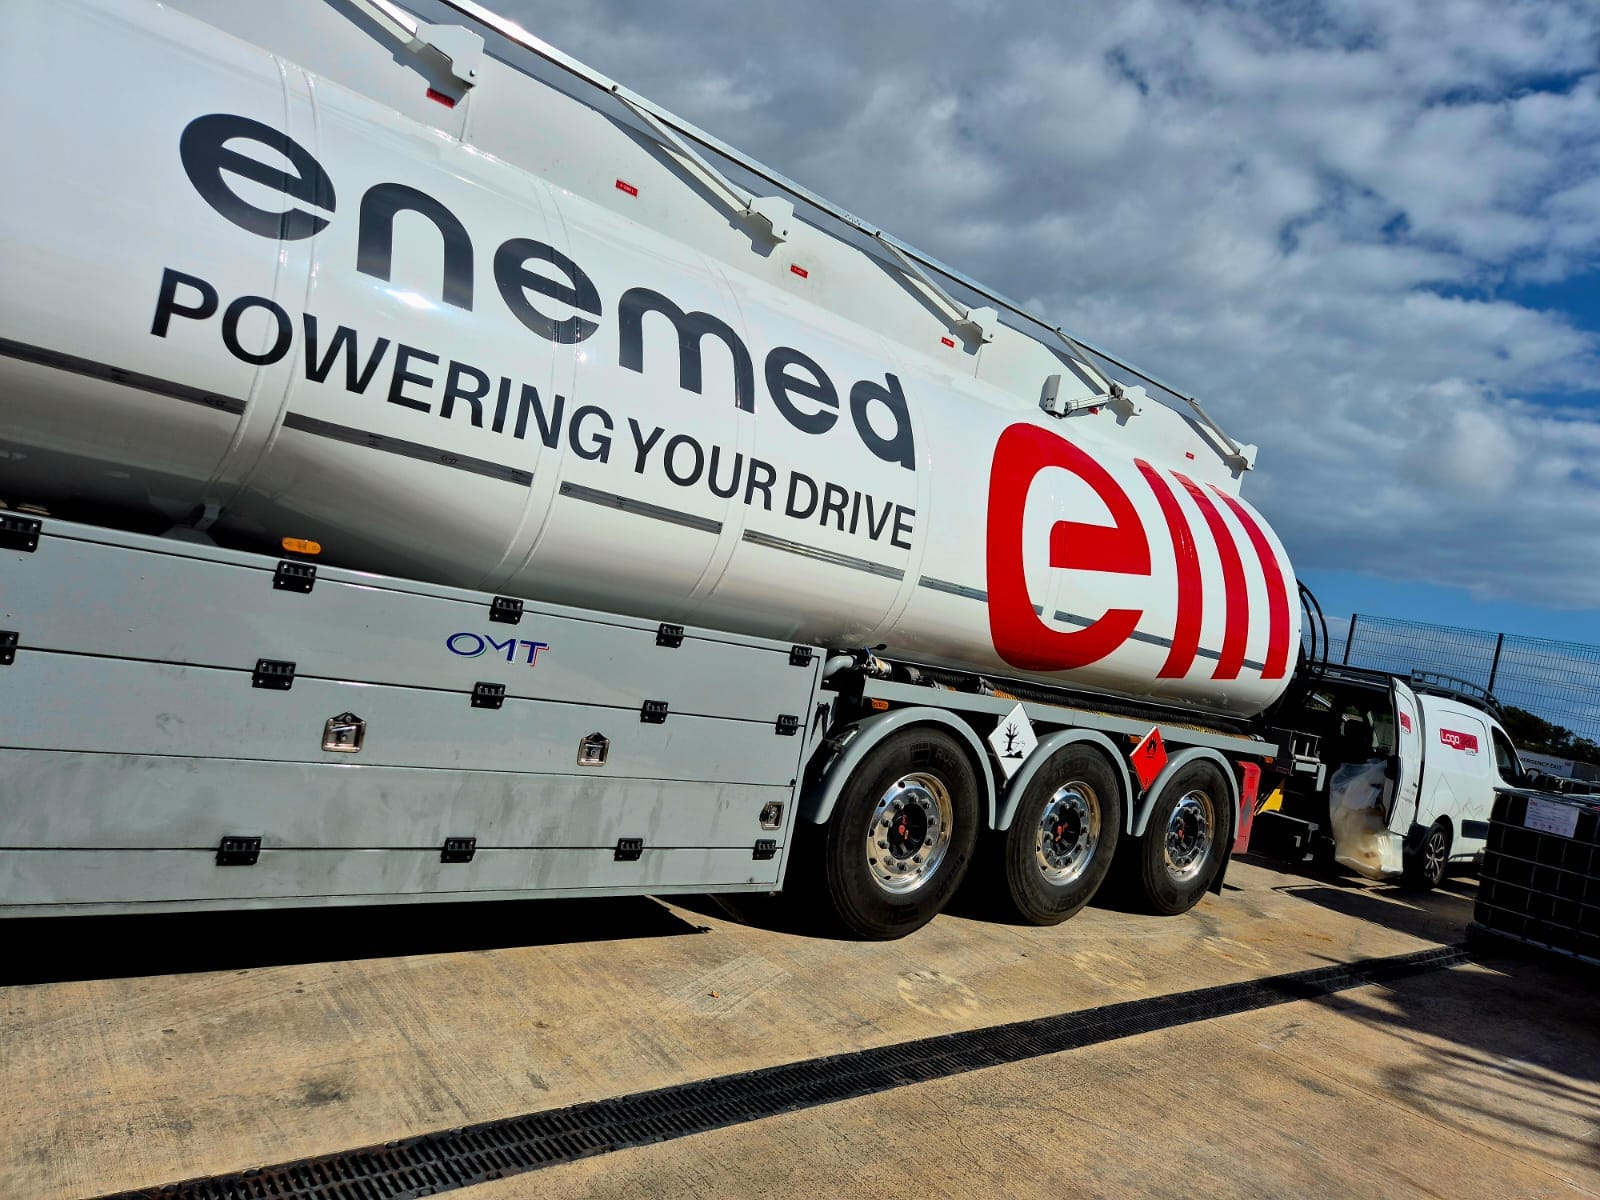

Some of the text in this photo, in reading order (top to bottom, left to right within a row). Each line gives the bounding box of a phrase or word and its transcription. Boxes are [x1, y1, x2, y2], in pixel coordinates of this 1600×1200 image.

[151, 267, 916, 551] POWERING YOUR DRIVE
[179, 113, 916, 472] enemed
[446, 632, 550, 667] OMT
